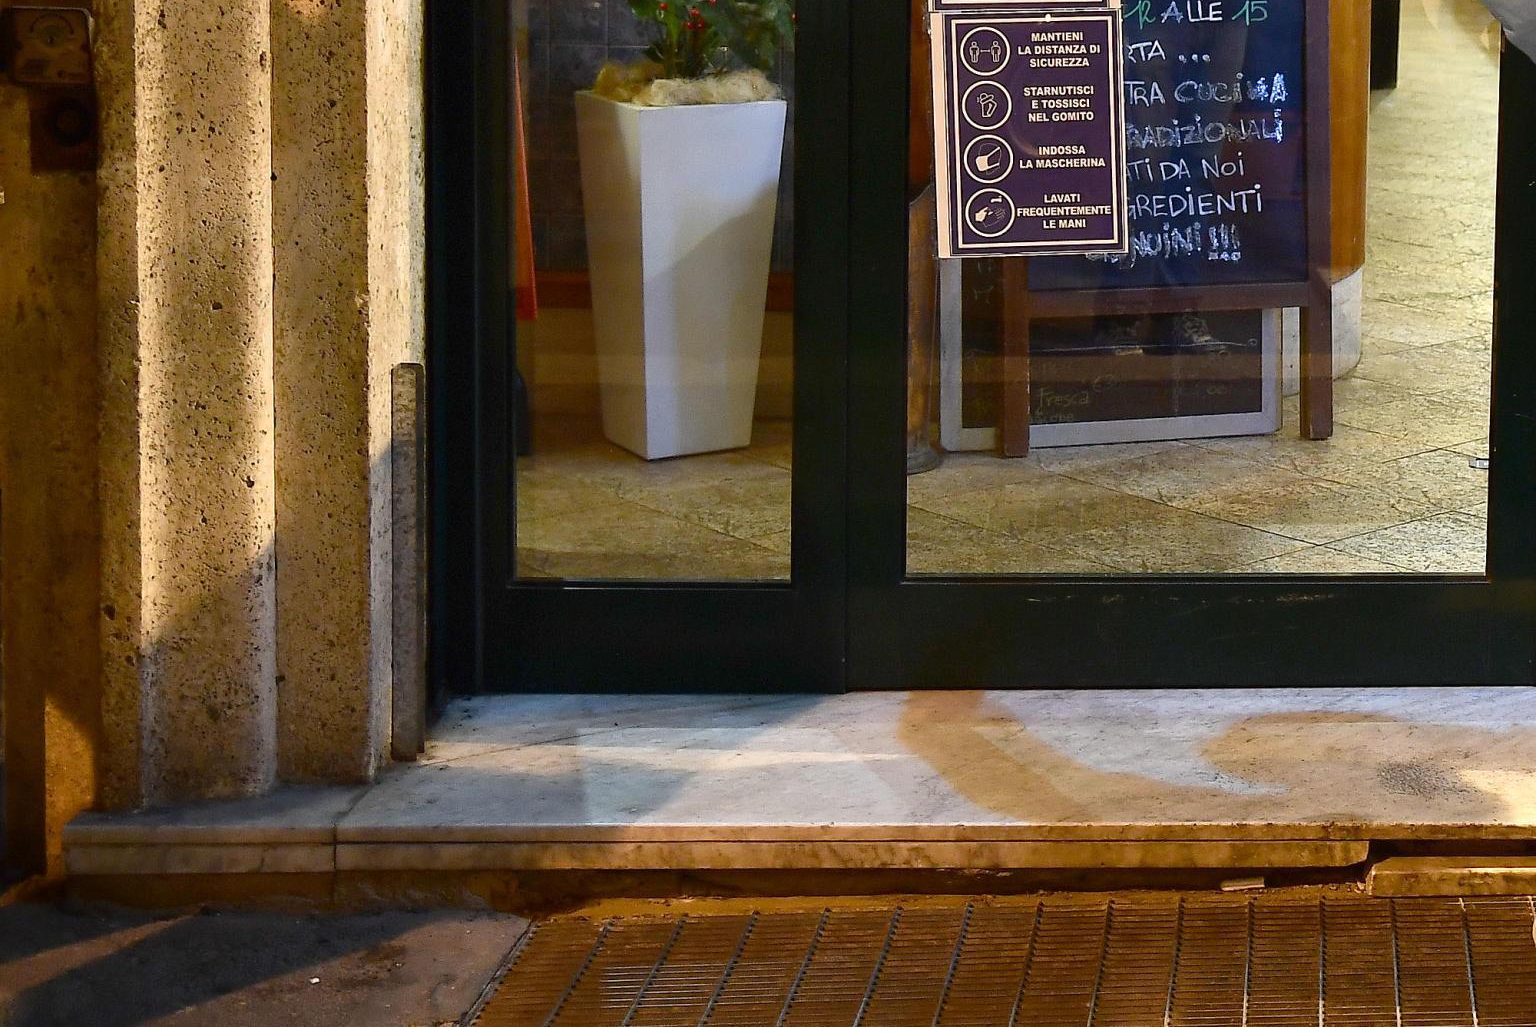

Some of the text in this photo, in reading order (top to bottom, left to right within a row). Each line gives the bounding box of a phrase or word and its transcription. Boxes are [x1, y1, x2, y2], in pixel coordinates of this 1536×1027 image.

[1232, 0, 1268, 26] 15
[1031, 32, 1083, 41] MANTIENI
[1018, 44, 1100, 55] LA DISTANZA DI
[1030, 58, 1089, 67] SICUREZZA
[1024, 86, 1094, 96] STARNUTISCI
[1032, 99, 1090, 109] E TOSSISCI
[1029, 112, 1094, 122] NEL GOMITO
[1039, 146, 1085, 155] INDOSSA
[1020, 158, 1105, 168] LA MASCHERINA
[1160, 158, 1191, 181] DA
[1044, 194, 1080, 203] LAVATI
[1017, 206, 1111, 217] FREQUENTEMENTE
[1043, 219, 1086, 228] LE MANI
